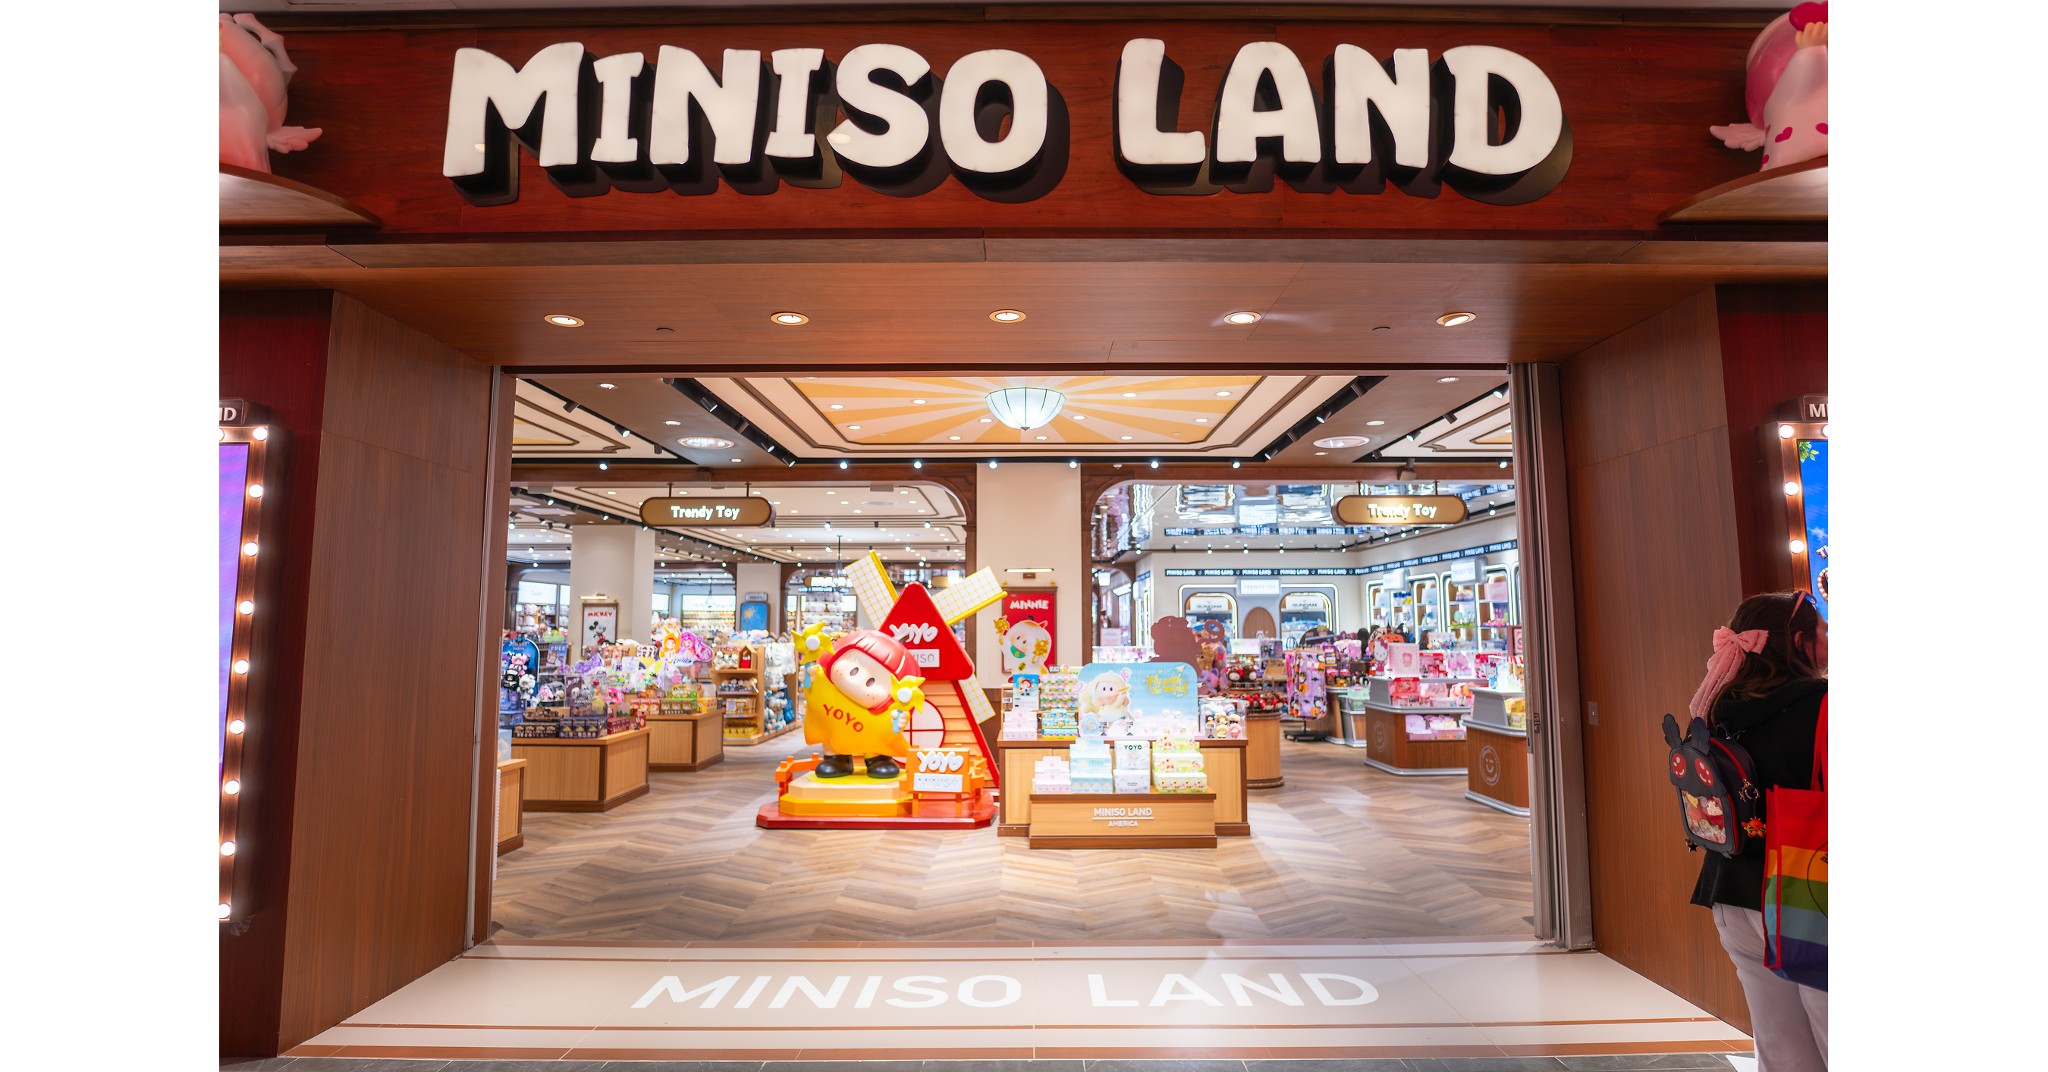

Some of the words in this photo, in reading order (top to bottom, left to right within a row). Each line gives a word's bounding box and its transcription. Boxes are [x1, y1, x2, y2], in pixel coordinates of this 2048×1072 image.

[443, 42, 1048, 177] MINISO
[1119, 38, 1562, 175] LAND
[1809, 403, 1828, 418] M
[671, 505, 714, 521] Trendy
[715, 505, 740, 521] Toy
[1367, 503, 1411, 520] Trendy
[1412, 503, 1438, 519] Toy
[1010, 599, 1049, 610] MINNIE
[822, 703, 865, 733] YOYO
[1123, 743, 1143, 751] YOYO
[916, 750, 965, 774] YOYO
[1093, 807, 1126, 817] MINISO
[1128, 807, 1153, 817] LAND
[630, 974, 1022, 1009] MINISO
[1087, 973, 1379, 1007] LAND
